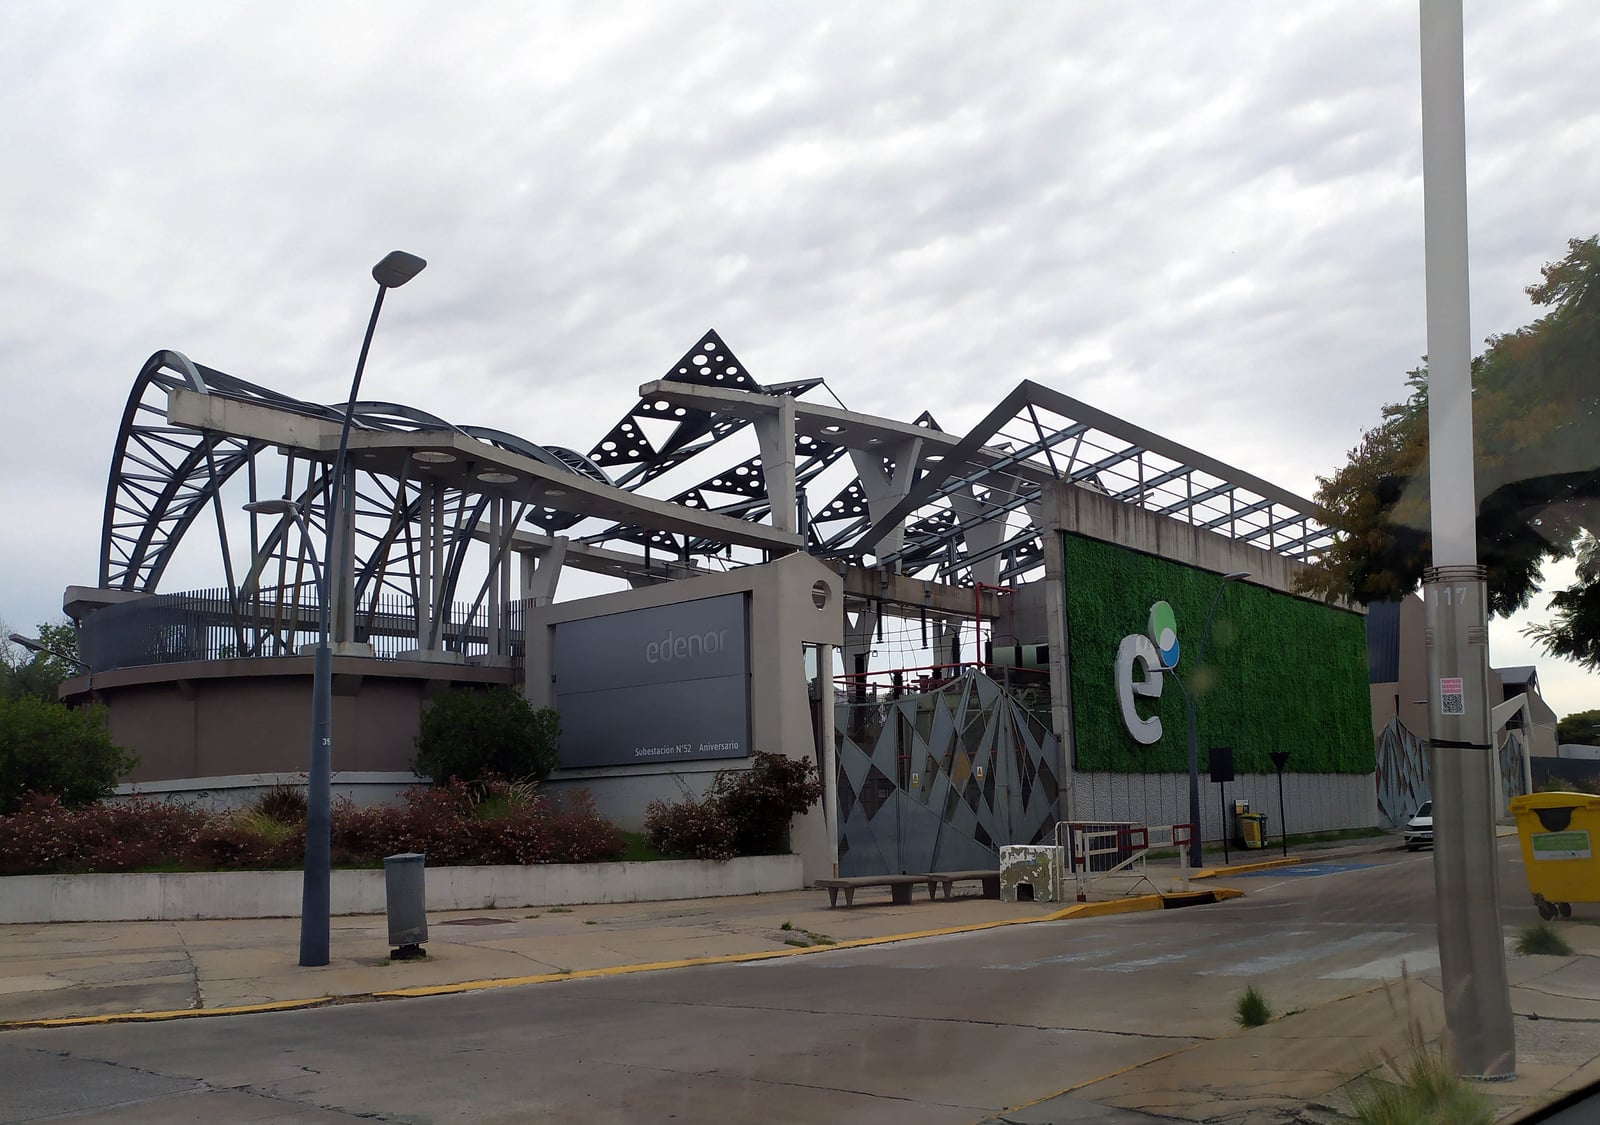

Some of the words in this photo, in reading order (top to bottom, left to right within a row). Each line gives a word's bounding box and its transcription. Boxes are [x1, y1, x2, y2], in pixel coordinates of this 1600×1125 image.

[1434, 587, 1467, 607] 117
[646, 629, 728, 664] edenor
[698, 739, 739, 752] Aniversario
